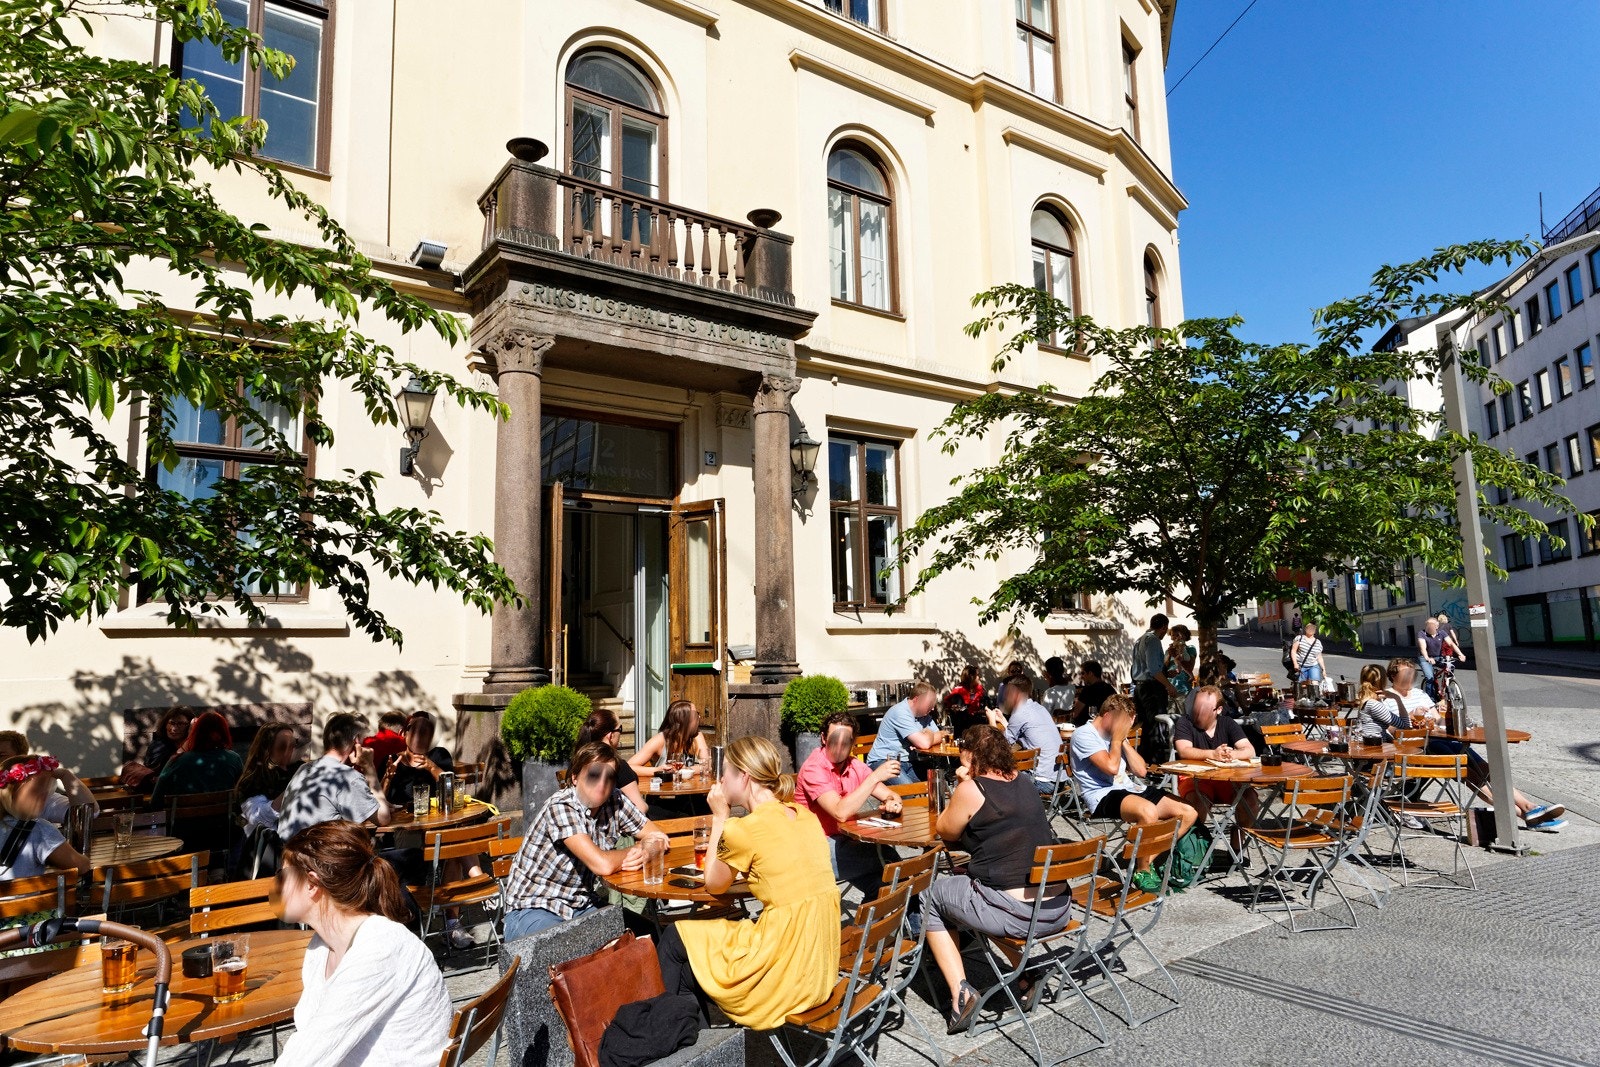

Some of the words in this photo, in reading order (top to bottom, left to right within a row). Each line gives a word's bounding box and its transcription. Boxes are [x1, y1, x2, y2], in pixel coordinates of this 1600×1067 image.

[533, 283, 697, 333] RIKSHOSPITALETS
[707, 321, 779, 350] APOTHEK
[601, 438, 614, 458] 2
